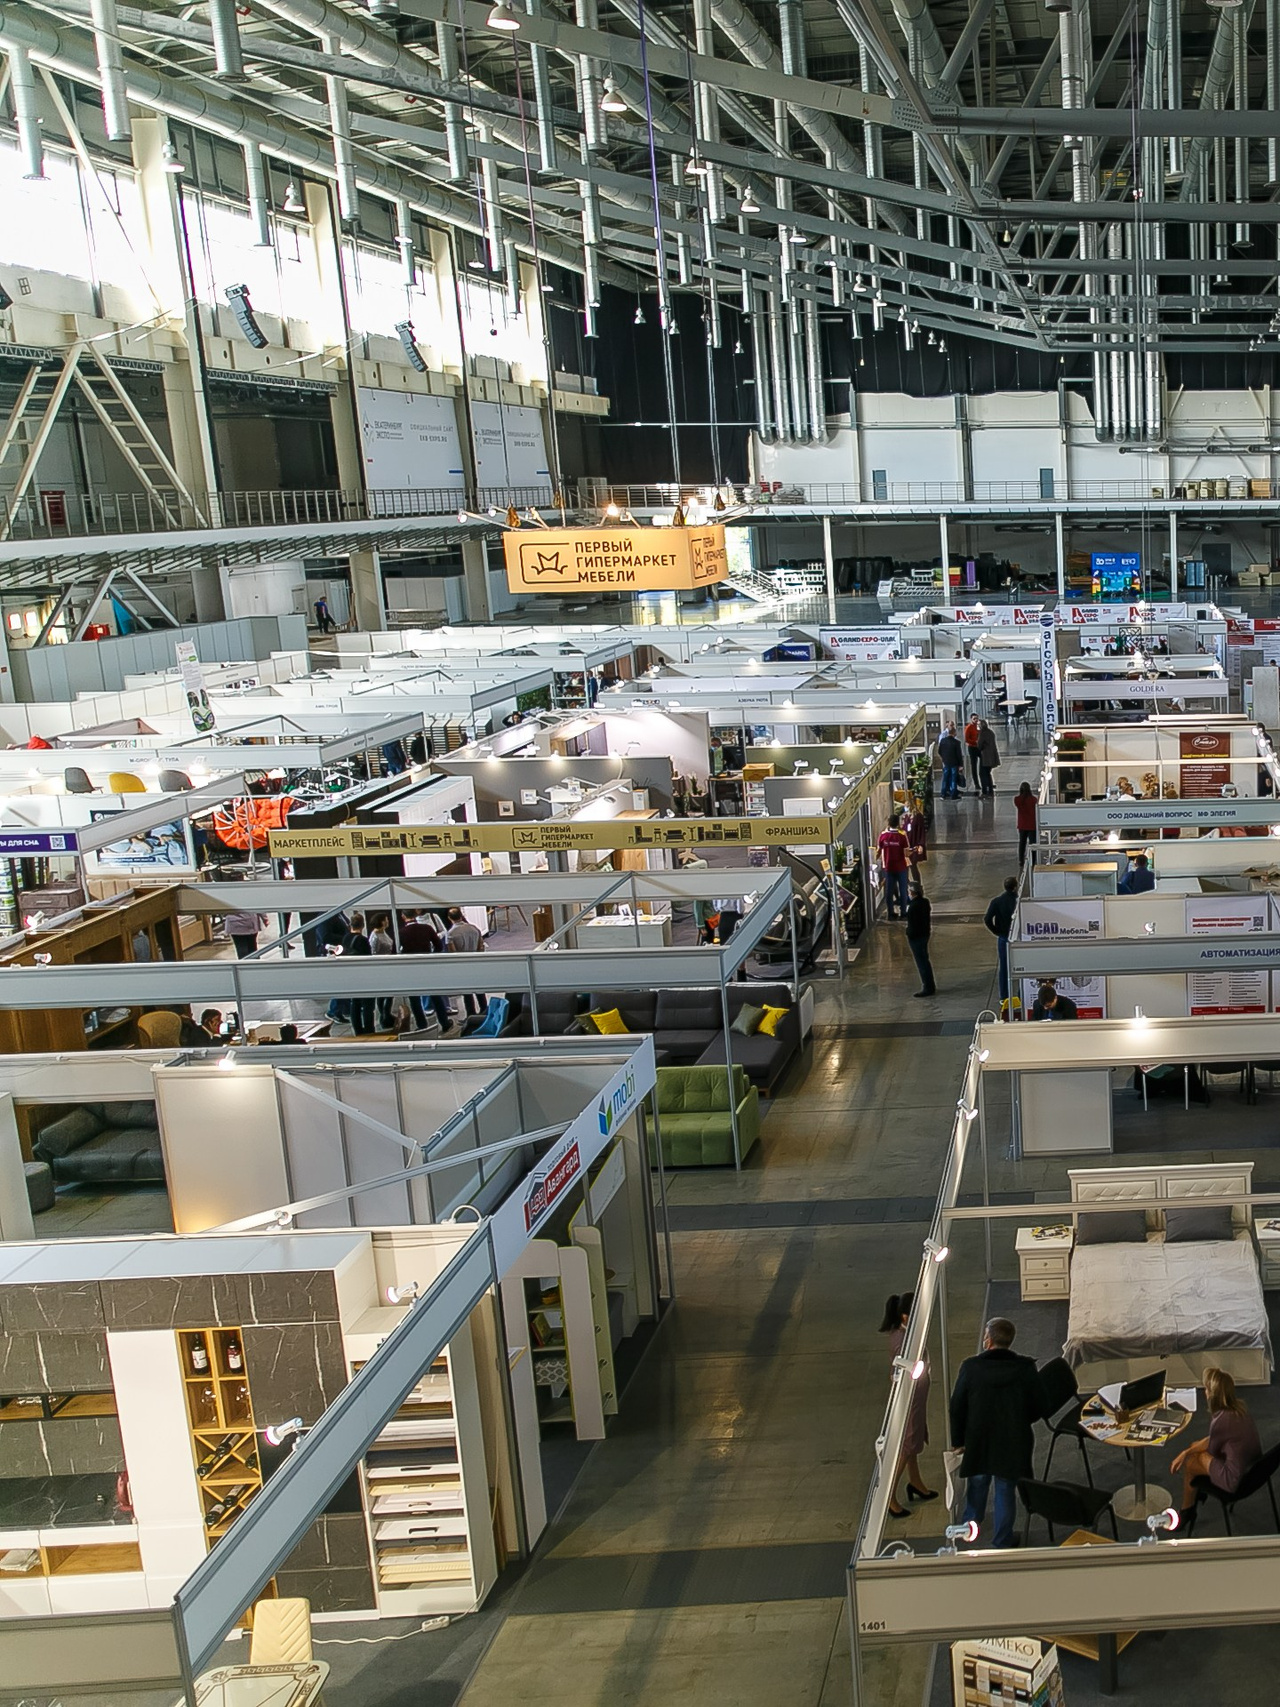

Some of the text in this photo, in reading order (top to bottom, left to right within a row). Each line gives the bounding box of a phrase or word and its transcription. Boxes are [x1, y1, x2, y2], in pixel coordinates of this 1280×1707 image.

[575, 537, 633, 553] ПЕРВЫЙ
[576, 554, 677, 568] ГИПЕРМАРКЕТ
[578, 570, 636, 583] МЕБЕЛИ
[1044, 630, 1055, 733] arcobaleno
[1129, 685, 1165, 693] GOLDERA
[1123, 811, 1164, 820] ДОМАШНИЙ
[1165, 811, 1193, 819] ВОПРОС
[540, 825, 571, 834] ПЕРВЫЙ
[765, 826, 820, 837] ФРАНШИЗА
[541, 832, 595, 841] ГИПЕРМАРКЕТ
[273, 837, 345, 849] МАРКЕТПЛЕЙС
[542, 840, 573, 848] МЕБЕЛИ
[1026, 923, 1089, 935] bCAD Мебель
[612, 1064, 636, 1115] mobi
[546, 1151, 580, 1198] Авангард
[860, 1620, 887, 1633] 1401
[980, 1638, 1034, 1656] ЛМЕКО
